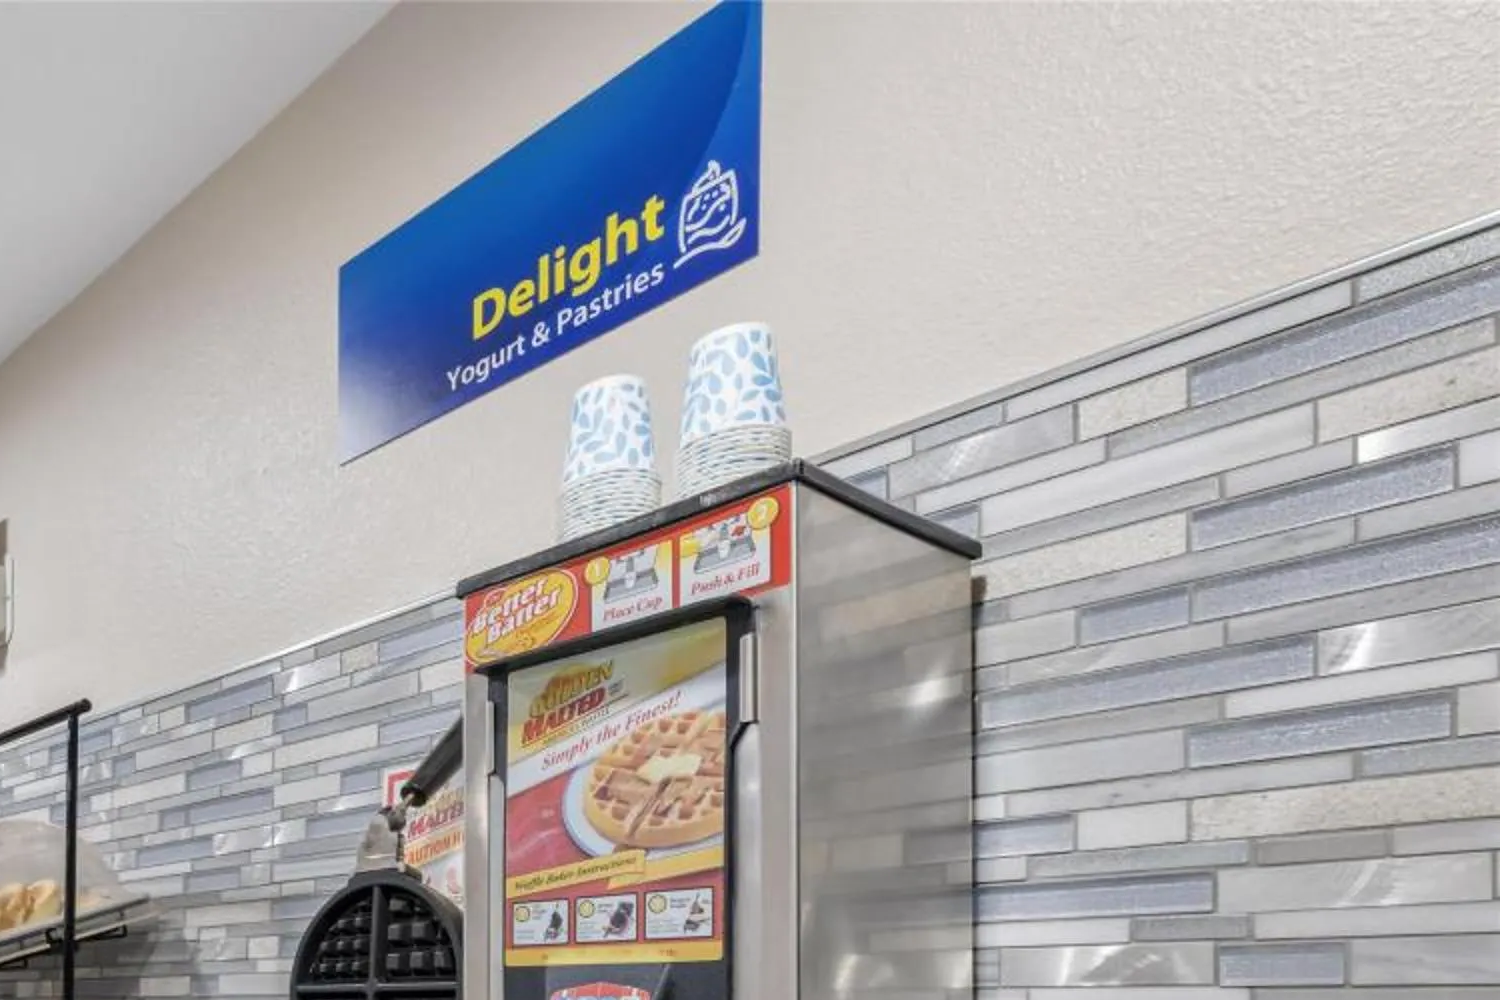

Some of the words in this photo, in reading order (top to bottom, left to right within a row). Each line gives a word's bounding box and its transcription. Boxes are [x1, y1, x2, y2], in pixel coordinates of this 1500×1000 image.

[446, 334, 527, 392] Yogurt
[531, 324, 551, 349] &
[556, 262, 665, 335] Pastries
[471, 193, 666, 342] Delight
[541, 735, 592, 771] Simply
[596, 723, 621, 745] the
[624, 690, 682, 731] Finest!
